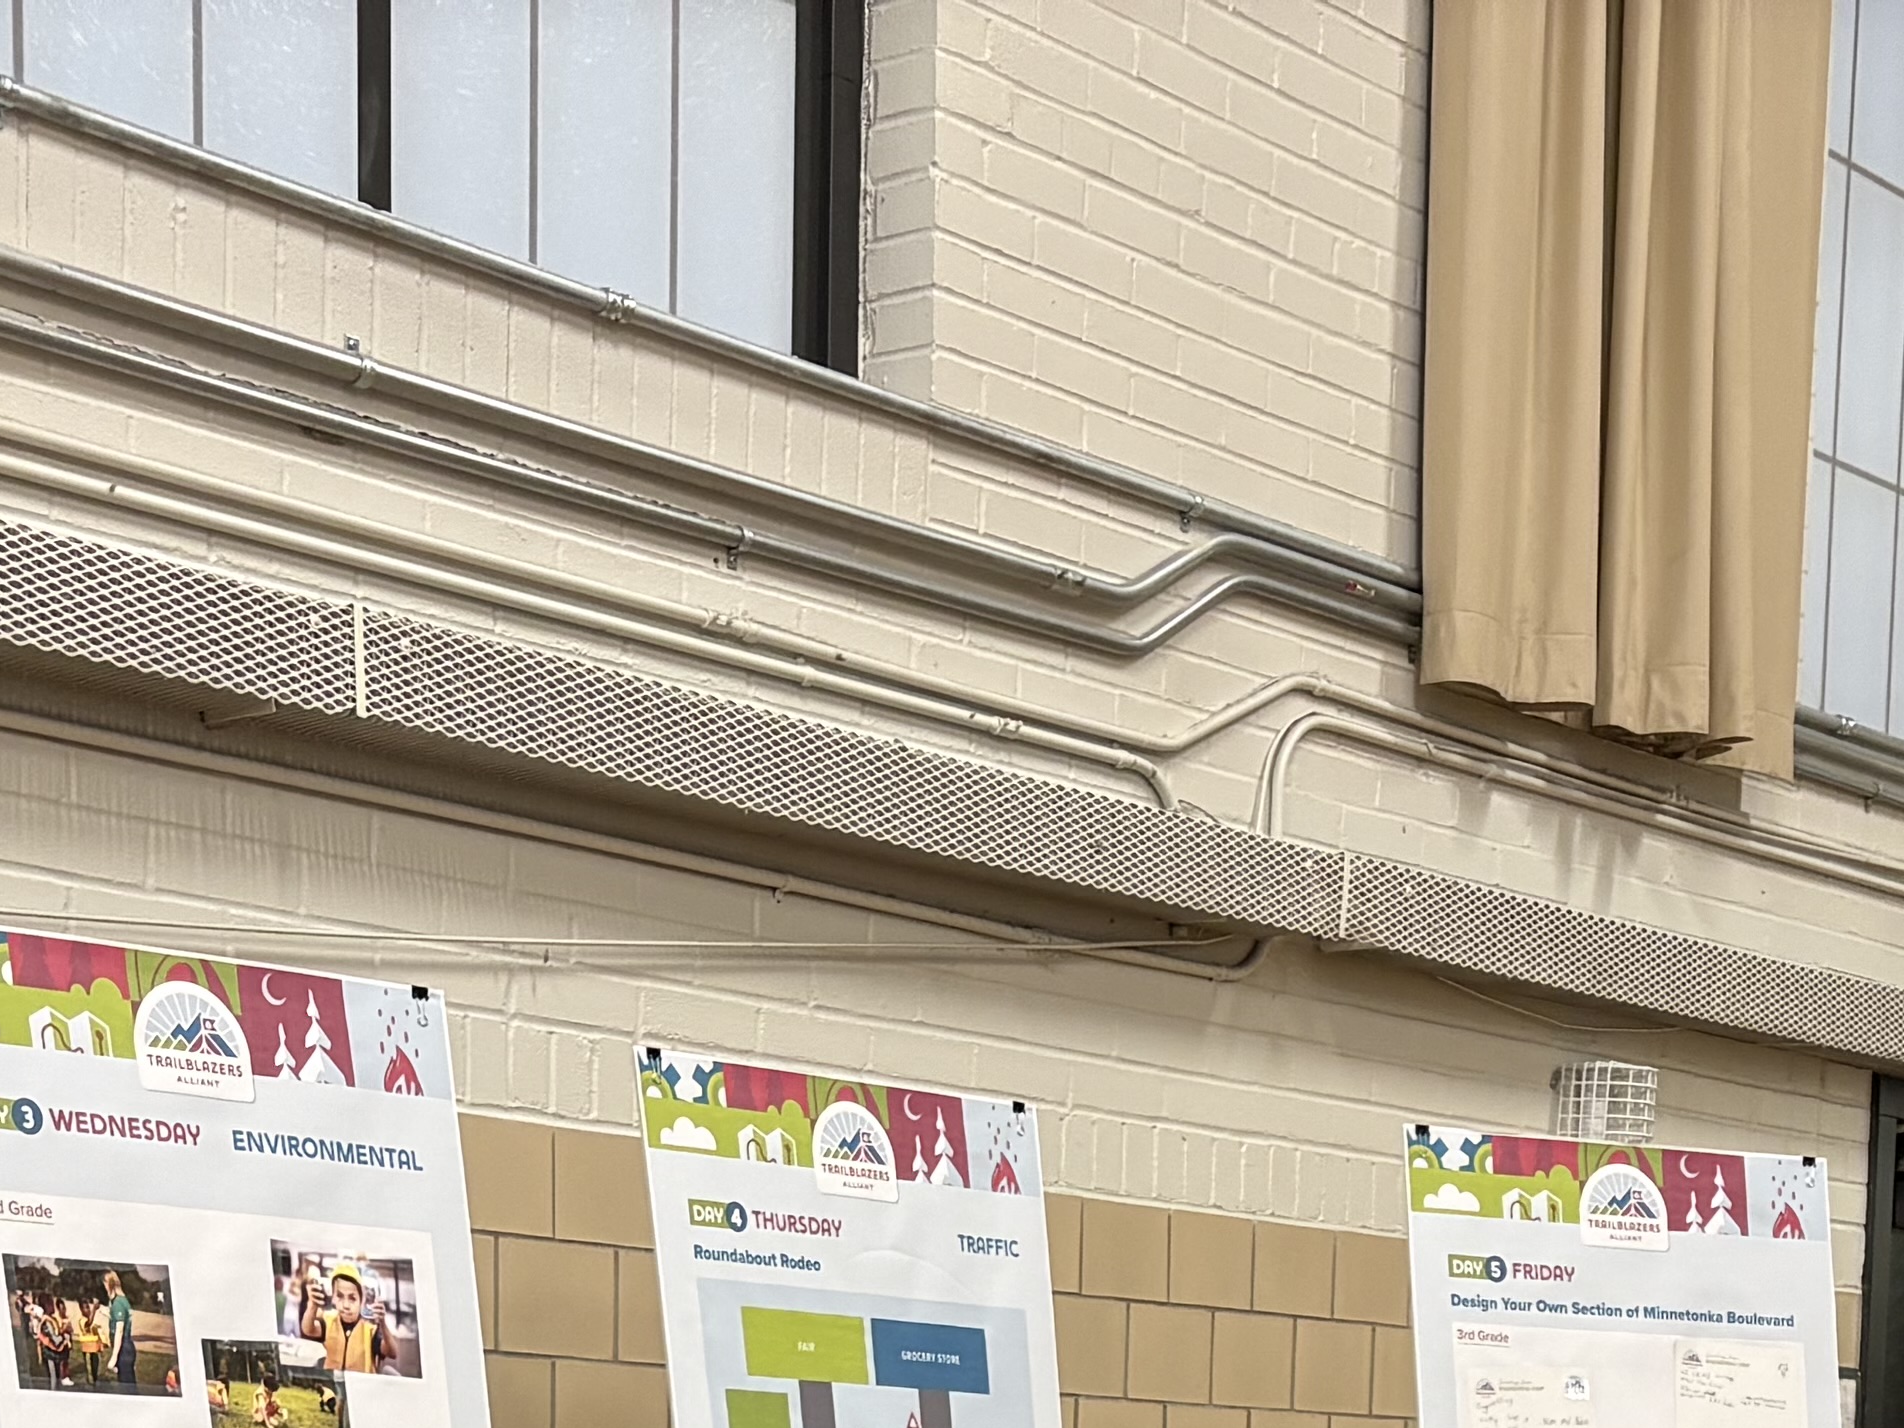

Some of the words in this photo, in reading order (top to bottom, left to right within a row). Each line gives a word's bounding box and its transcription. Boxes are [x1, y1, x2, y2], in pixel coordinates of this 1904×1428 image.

[145, 1054, 244, 1079] TRAILBLAZERS
[176, 1076, 221, 1089] ALLIANT
[21, 1106, 35, 1129] 3
[49, 1107, 201, 1147] WEDNESDAY
[232, 1129, 424, 1172] ENVIRONMENTAL
[821, 1163, 890, 1182] TRAILBLAZERS
[8, 1201, 53, 1221] Grade
[692, 1204, 723, 1223] DAY
[730, 1206, 743, 1227] 4
[751, 1210, 842, 1238] THURSDAY
[1588, 1219, 1661, 1233] TRAILBLAZERS
[957, 1233, 1020, 1258] TRAFFIC
[693, 1245, 778, 1269] Roundabout
[780, 1254, 821, 1272] Rodeo
[1452, 1259, 1482, 1275] DAY
[1490, 1260, 1501, 1278] 5
[1512, 1263, 1575, 1282] FRIDAY
[1451, 1293, 1498, 1311] Design
[1501, 1298, 1532, 1312] Your
[1536, 1300, 1568, 1313] Own
[1572, 1302, 1622, 1318] Section
[1626, 1305, 1639, 1318] of
[1644, 1306, 1723, 1323] Minnetonka
[1727, 1311, 1795, 1327] Boulevard
[798, 1342, 816, 1352] FAIR
[1457, 1329, 1474, 1341] 3rd
[1478, 1330, 1509, 1343] Grade
